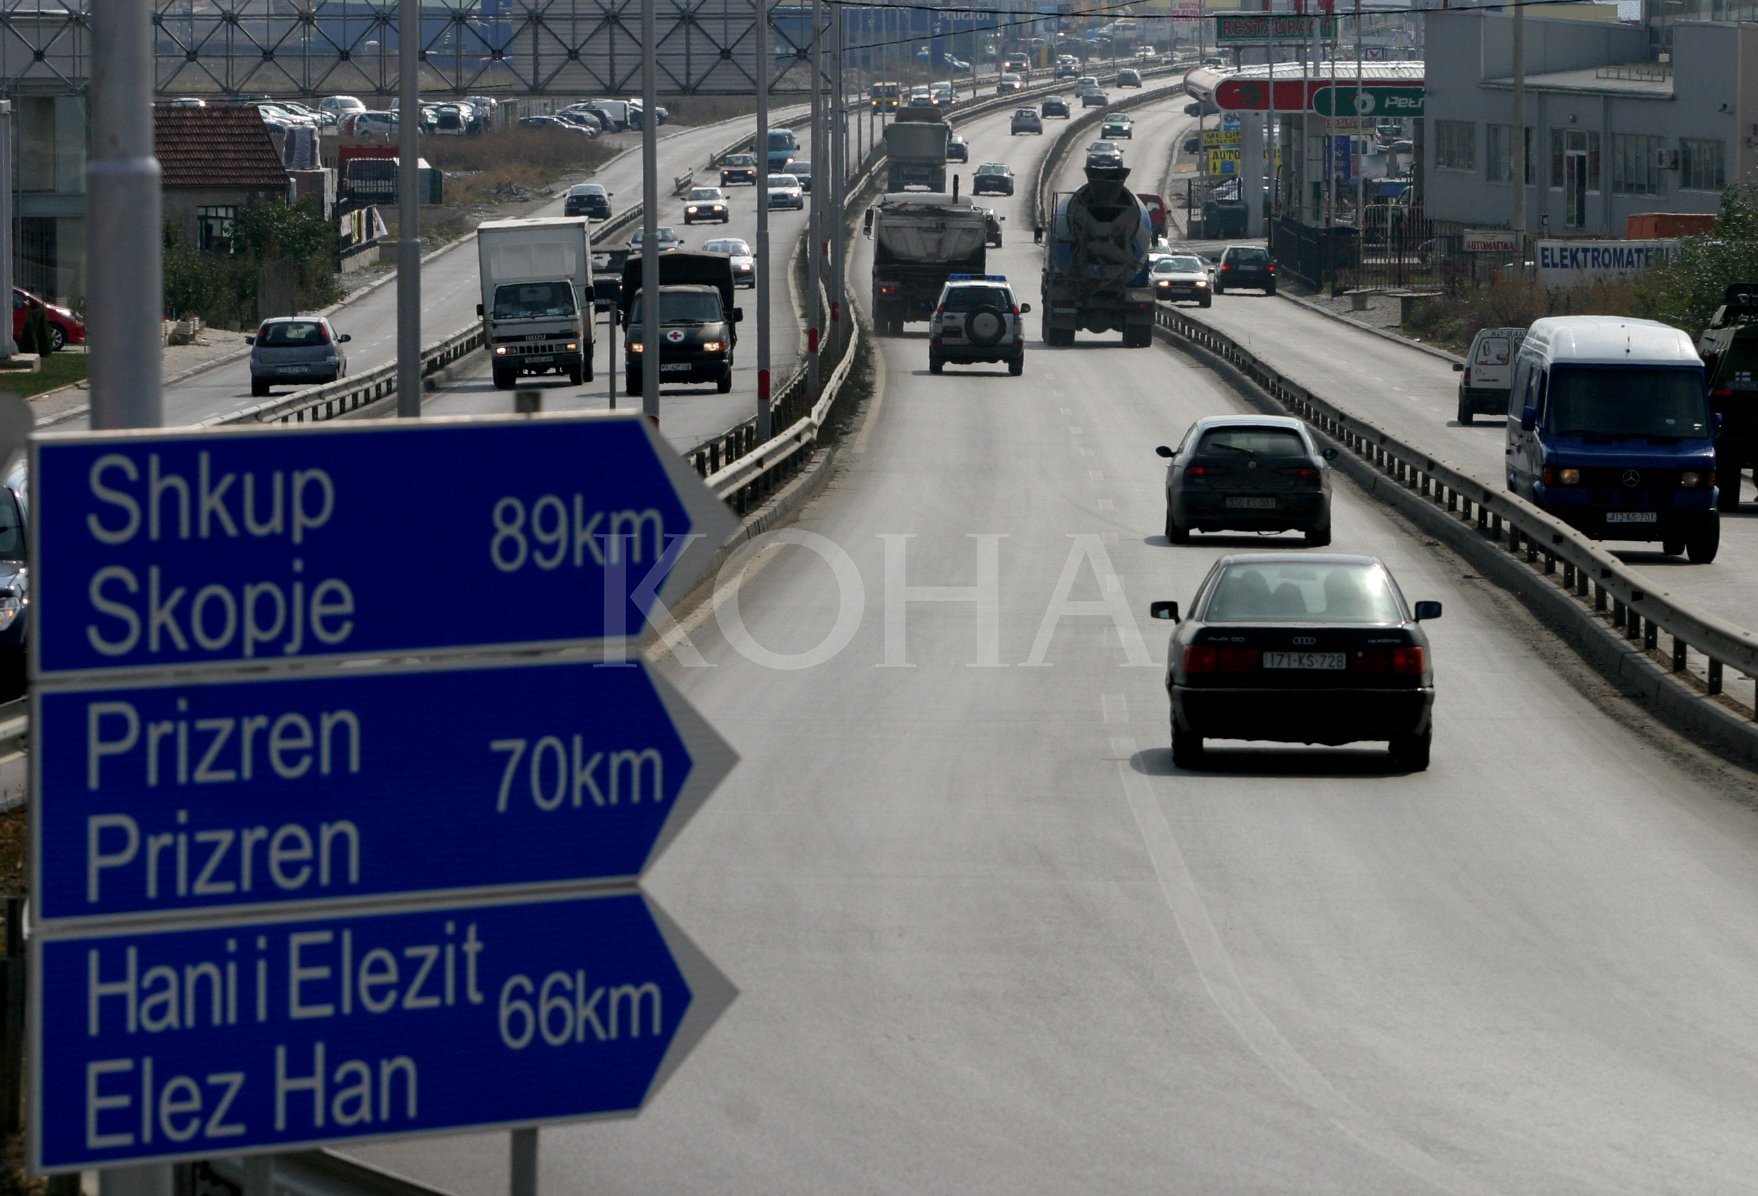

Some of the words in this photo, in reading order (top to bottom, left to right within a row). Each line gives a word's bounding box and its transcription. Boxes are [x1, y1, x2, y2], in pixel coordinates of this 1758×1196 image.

[937, 11, 991, 21] PEUGEOT
[1222, 18, 1331, 36] RESTAURAT
[87, 450, 335, 545] Shkup
[490, 493, 664, 572] 89km
[87, 558, 355, 657] Skopje
[1269, 653, 1345, 668] 171-KS-728
[87, 697, 361, 792] Prizren
[490, 734, 663, 814] 70km
[87, 808, 361, 904] Prizren
[88, 938, 238, 1037] Hani
[256, 934, 268, 1022] i
[289, 921, 485, 1020] Elezit
[499, 969, 662, 1051] 66km
[86, 1056, 246, 1150] Elez
[275, 1041, 418, 1132] Han
